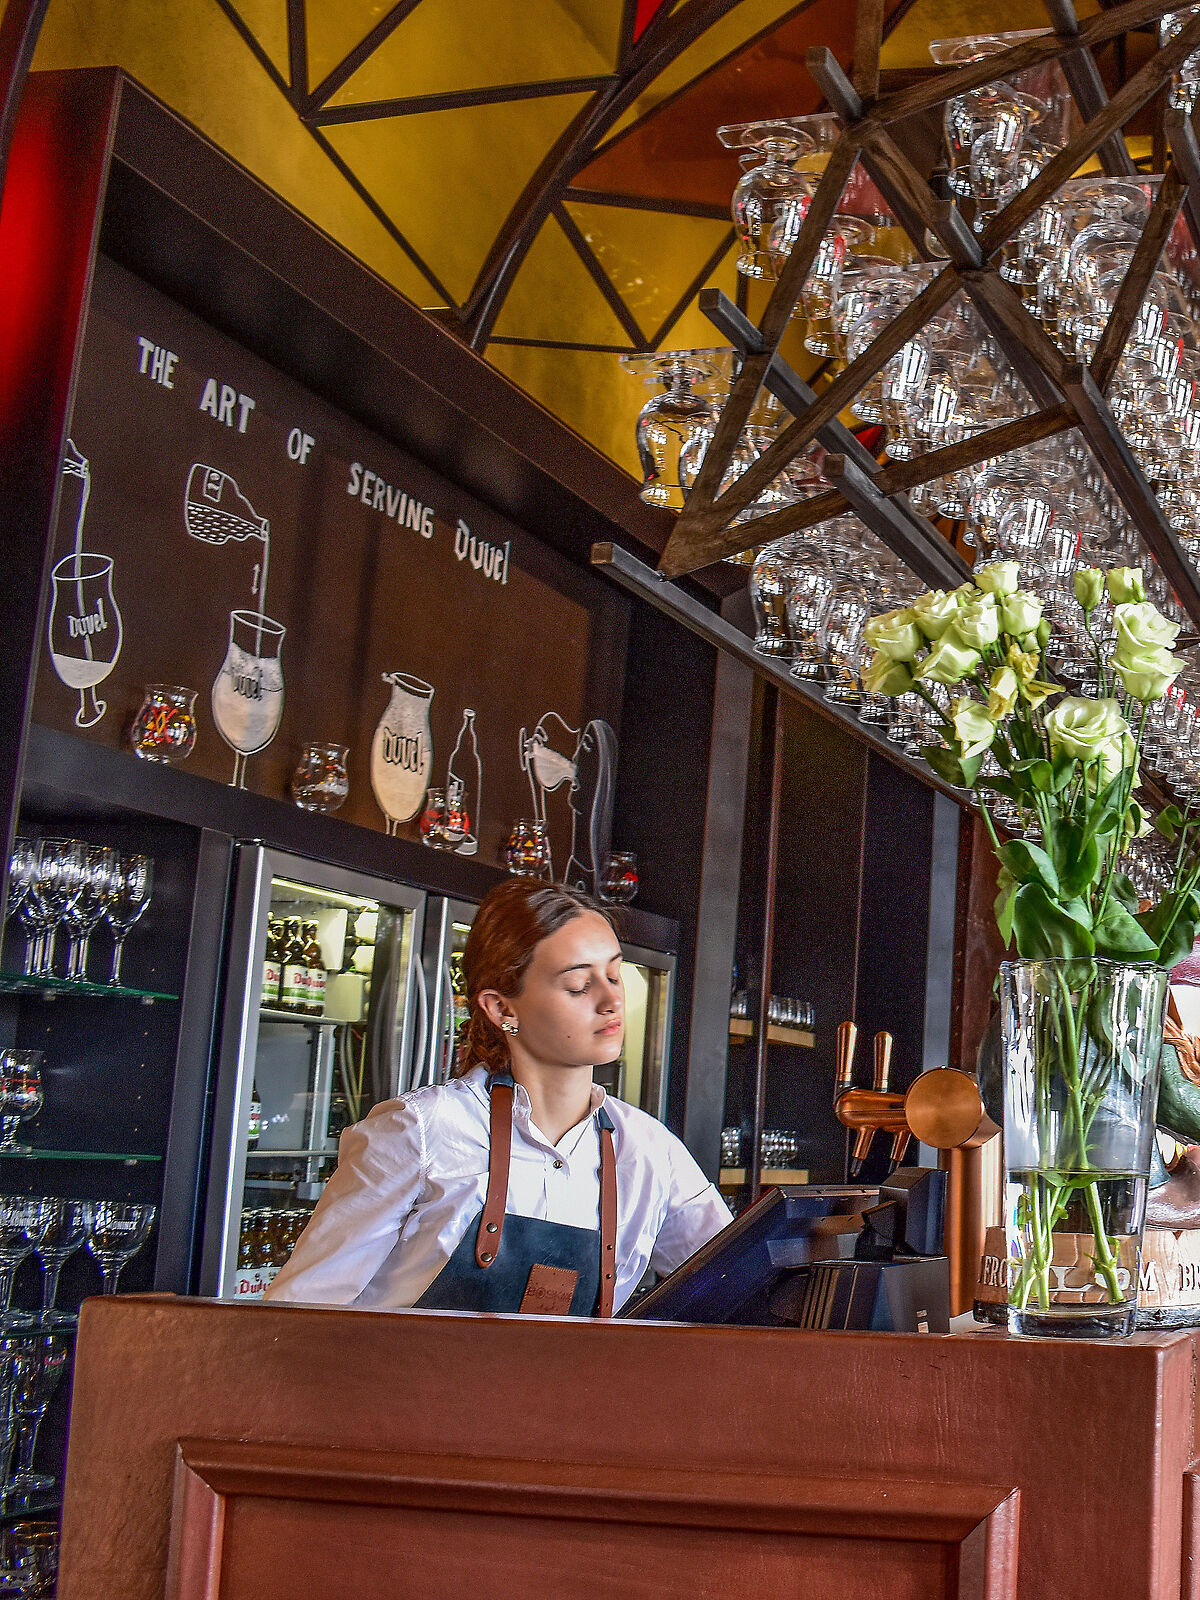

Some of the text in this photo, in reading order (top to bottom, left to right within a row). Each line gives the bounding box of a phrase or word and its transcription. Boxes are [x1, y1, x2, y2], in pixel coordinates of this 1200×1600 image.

[137, 336, 512, 585] THE ART OF SERVING Duvel
